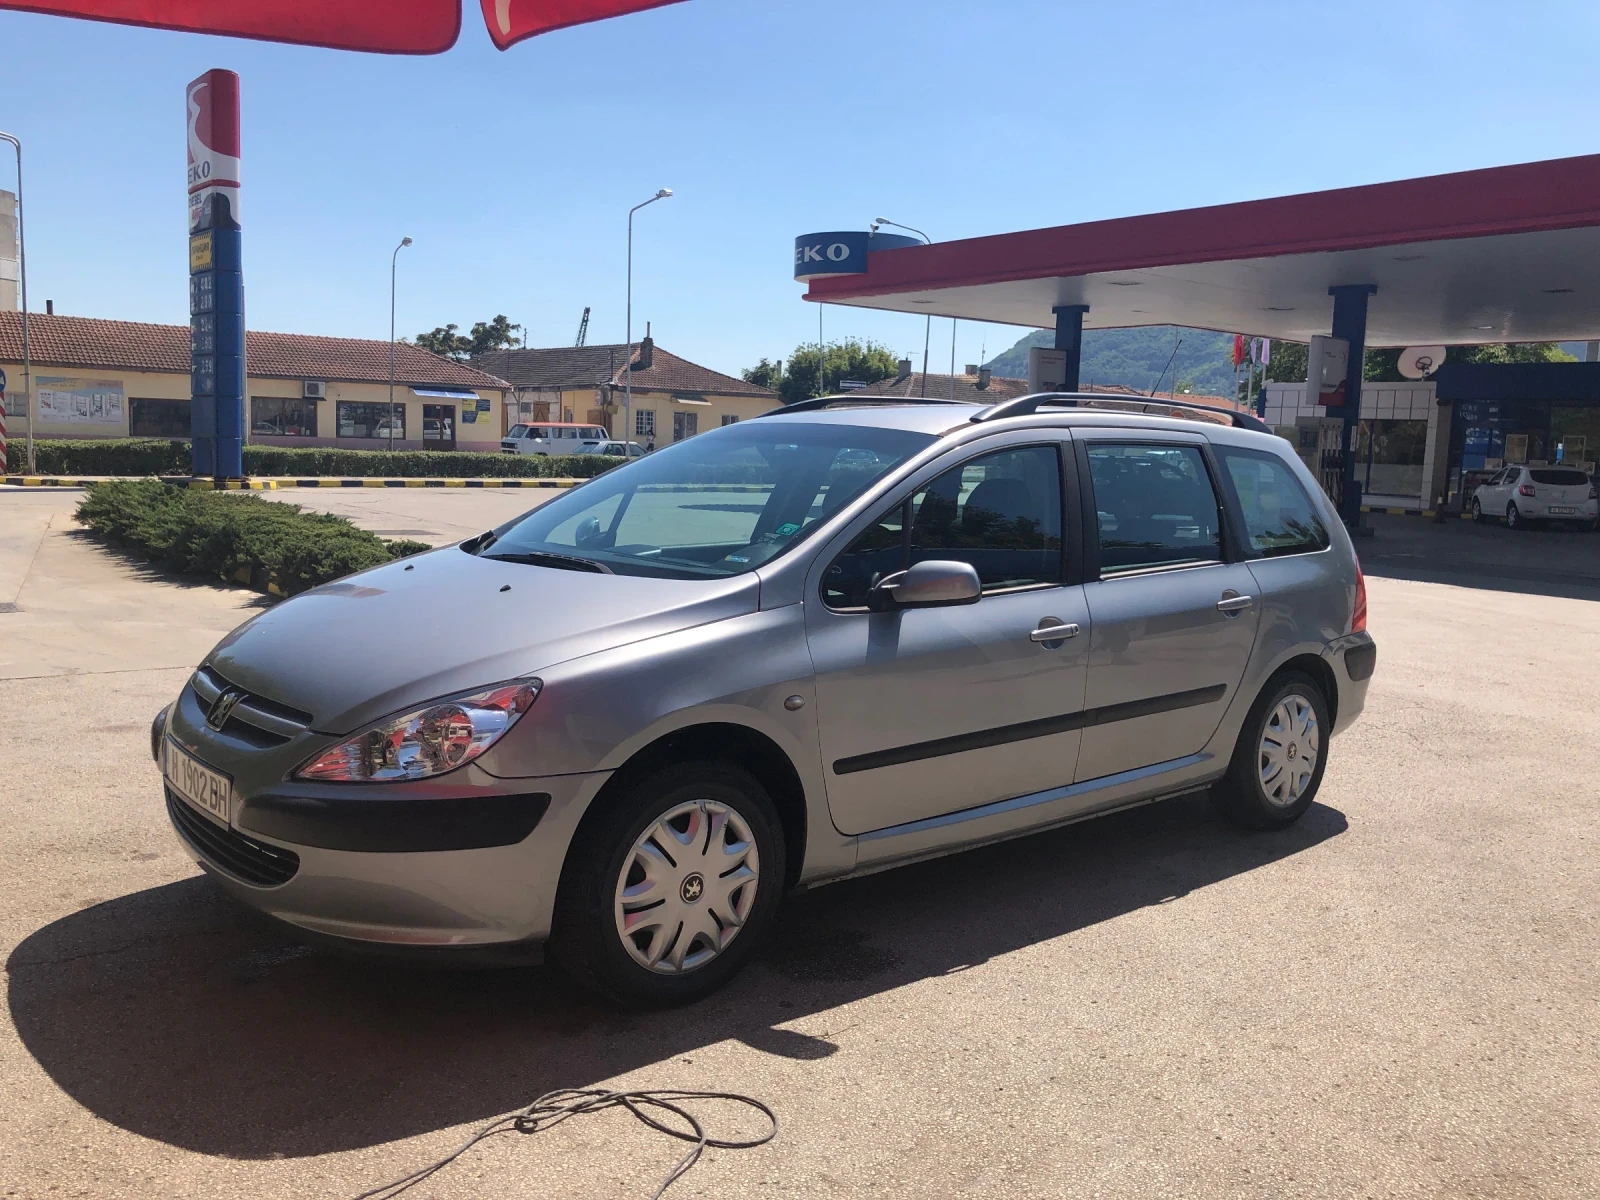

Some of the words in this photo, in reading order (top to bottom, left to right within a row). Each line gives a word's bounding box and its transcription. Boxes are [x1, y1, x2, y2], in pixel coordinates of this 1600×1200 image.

[188, 160, 211, 184] EKO
[795, 243, 850, 265] EKO
[172, 748, 179, 783] H
